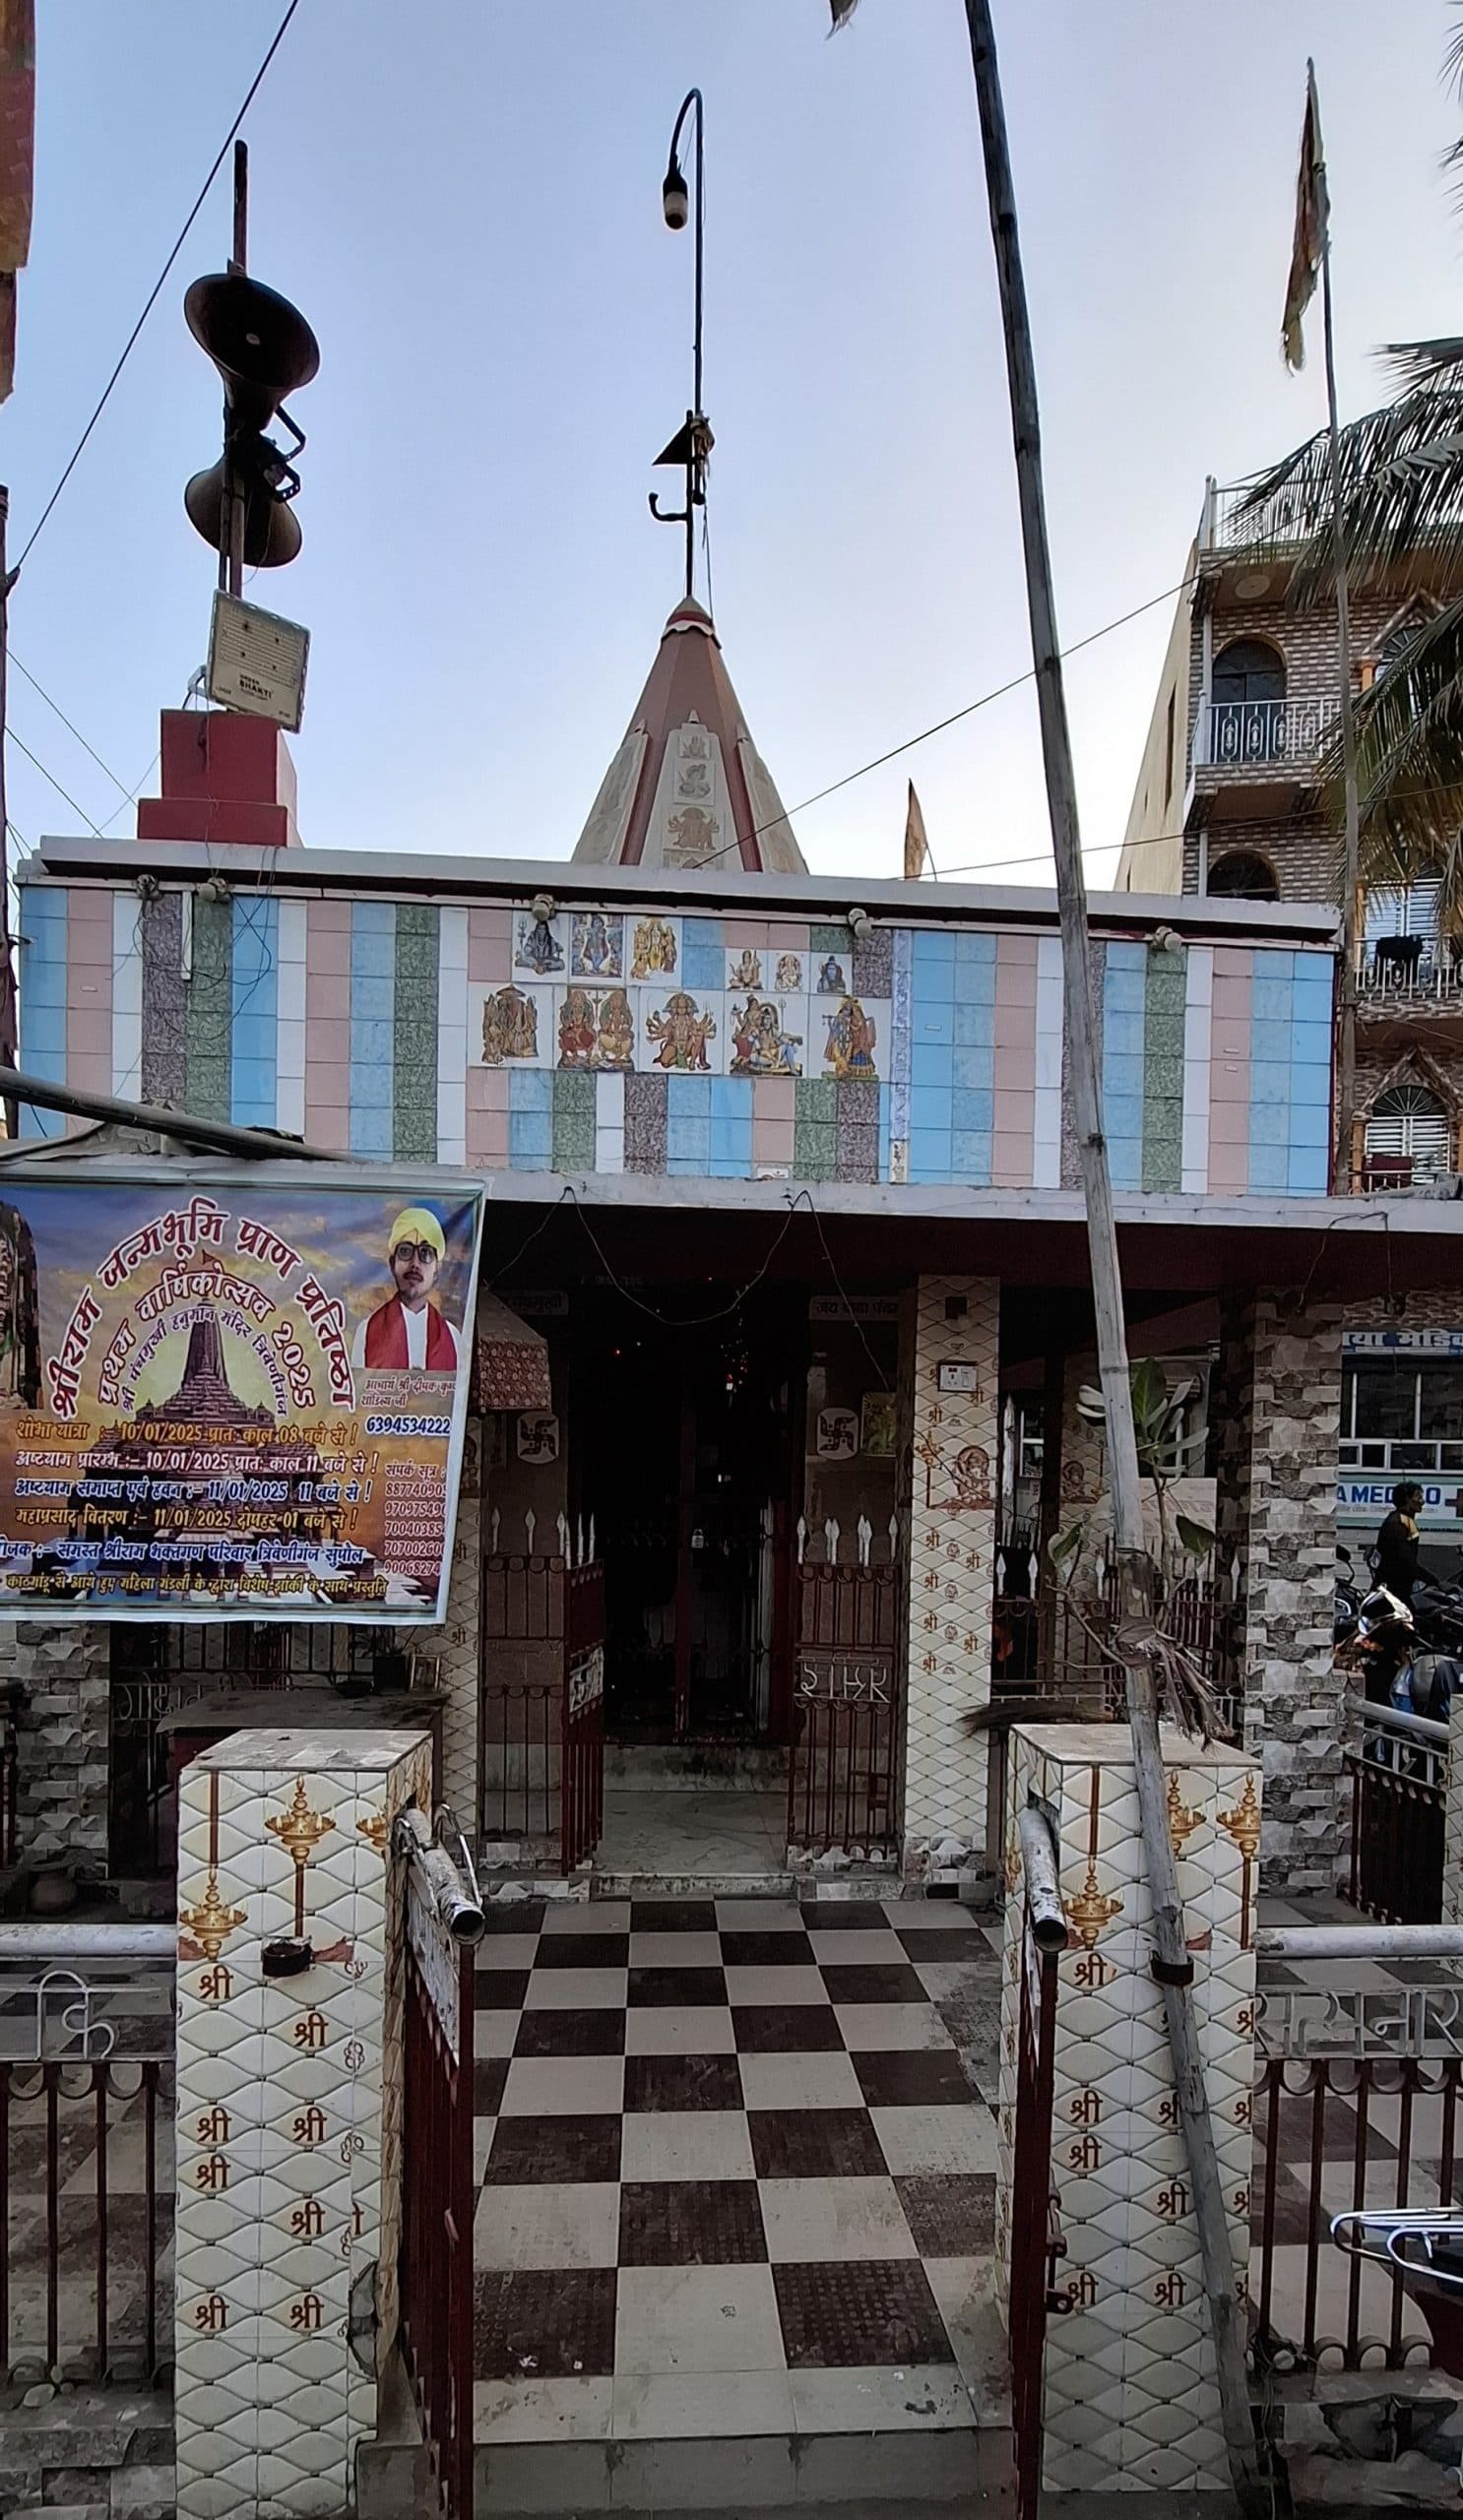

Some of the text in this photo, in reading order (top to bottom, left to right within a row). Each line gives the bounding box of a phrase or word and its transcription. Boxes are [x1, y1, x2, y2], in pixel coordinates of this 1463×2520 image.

[239, 679, 272, 700] BHAKTI
[48, 1287, 101, 1418] श्रीराम
[97, 1196, 229, 1290] जन्मभूमि
[236, 1219, 302, 1279] प्राण
[98, 1260, 315, 1408] प्रथम वार्षिकोत्सव 2025
[121, 1421, 201, 1441] 10/01/2025
[242, 1427, 273, 1443] काल
[280, 1427, 299, 1443] 08
[331, 1422, 347, 1444] से
[365, 1415, 451, 1436] 6394534222
[147, 1451, 228, 1471] 10/01/2025
[270, 1457, 301, 1472] काल
[306, 1455, 318, 1472] 11
[323, 1451, 348, 1473] बजे
[351, 1452, 367, 1473] से
[208, 1480, 288, 1501] 11/01/2025
[299, 1482, 312, 1501] 11
[317, 1479, 342, 1501] बजे
[345, 1479, 361, 1502] से
[1352, 1485, 1441, 1505] MEDO
[83, 1504, 129, 1525] वितरण
[155, 1508, 231, 1527] 11/01/2025
[283, 1511, 298, 1528] 01
[303, 1508, 327, 1529] बजे
[331, 1509, 347, 1529] से
[56, 1543, 101, 1559] समस्त
[104, 1537, 148, 1560] श्रीराम
[208, 1540, 254, 1565] परिवार
[200, 1965, 233, 1998] श्री
[1074, 1953, 1107, 1985] श्री
[294, 2012, 328, 2047] श्री
[1070, 2090, 1103, 2122] श्री
[198, 2107, 231, 2141] श्री
[293, 2107, 327, 2141] श्री
[1069, 2135, 1102, 2169] श्री
[197, 2154, 230, 2188] श्री
[1157, 2181, 1189, 2214] श्री
[291, 2201, 325, 2235] श्री
[1155, 2272, 1186, 2305] श्री
[196, 2295, 229, 2329] श्री
[290, 2295, 324, 2328] श्री
